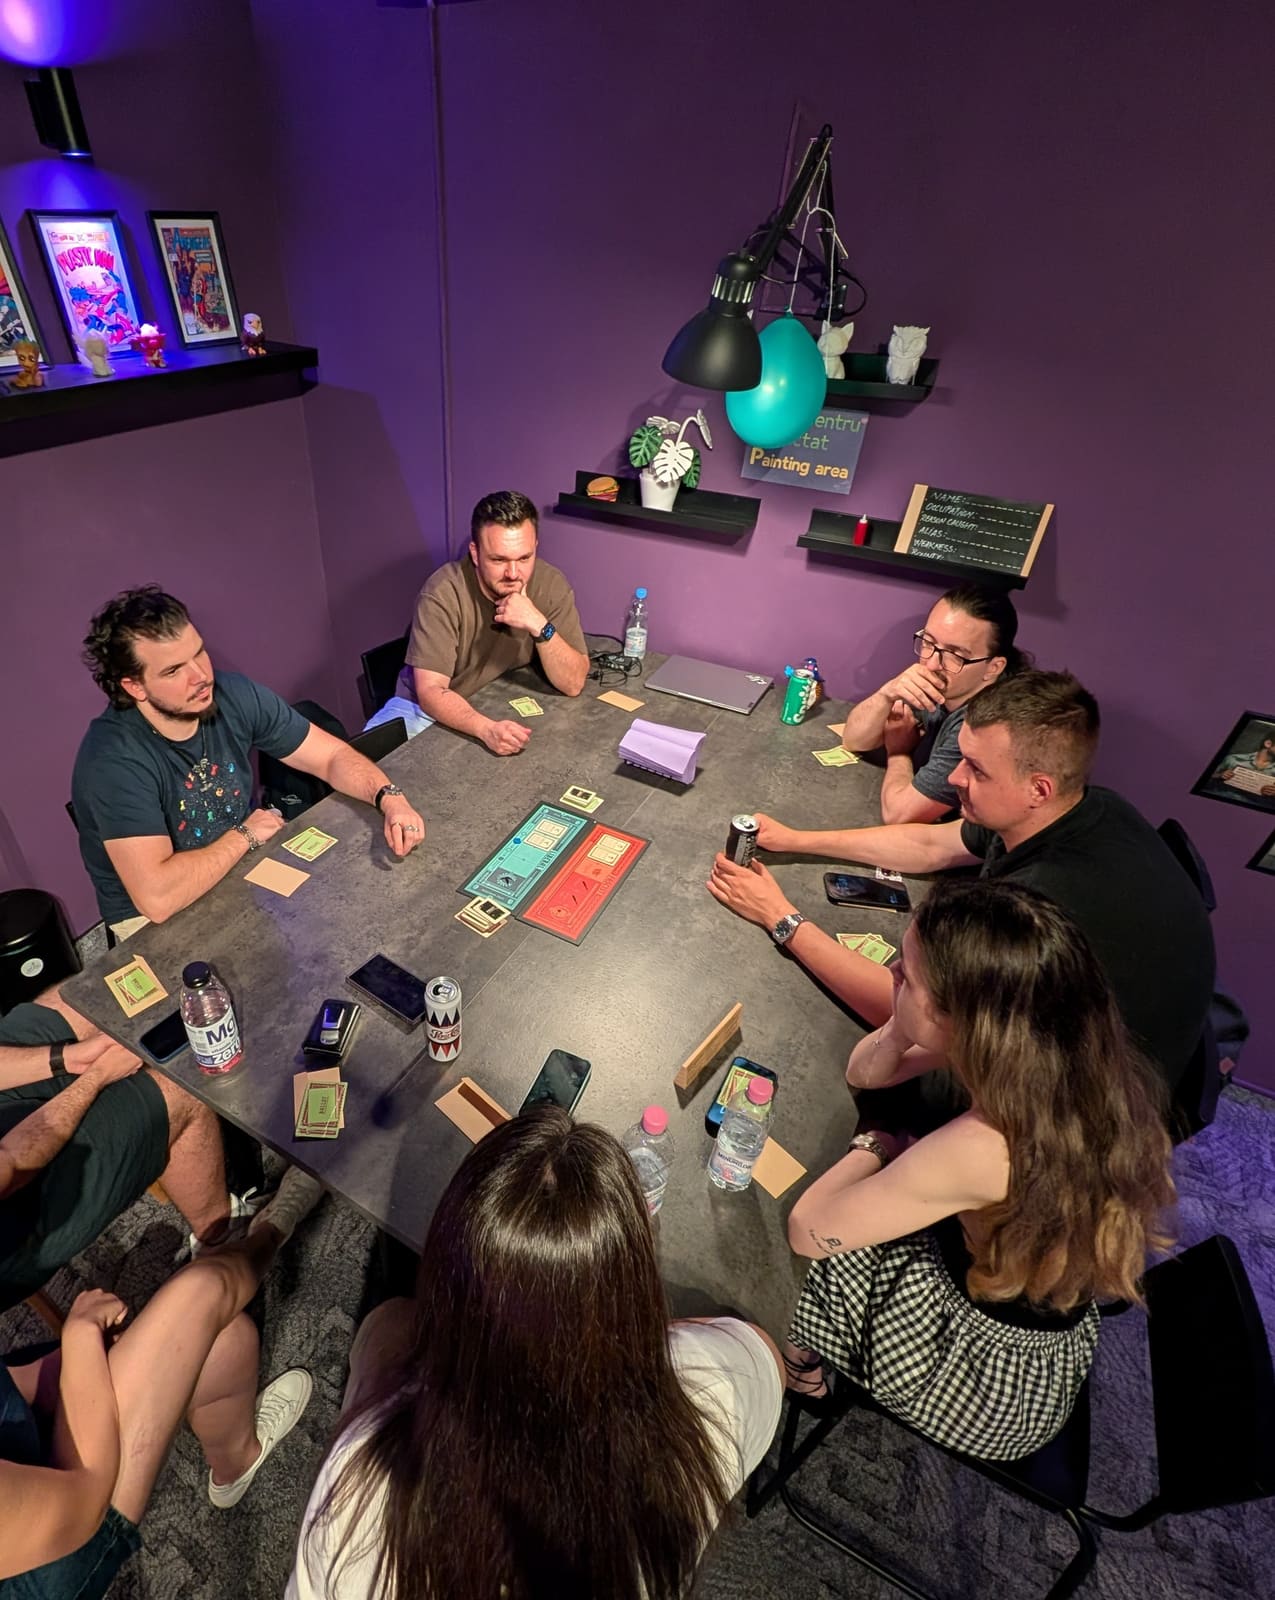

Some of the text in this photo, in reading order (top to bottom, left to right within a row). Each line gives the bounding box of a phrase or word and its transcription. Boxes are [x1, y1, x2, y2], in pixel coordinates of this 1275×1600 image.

[815, 414, 861, 432] entru
[750, 447, 849, 479] Painting area
